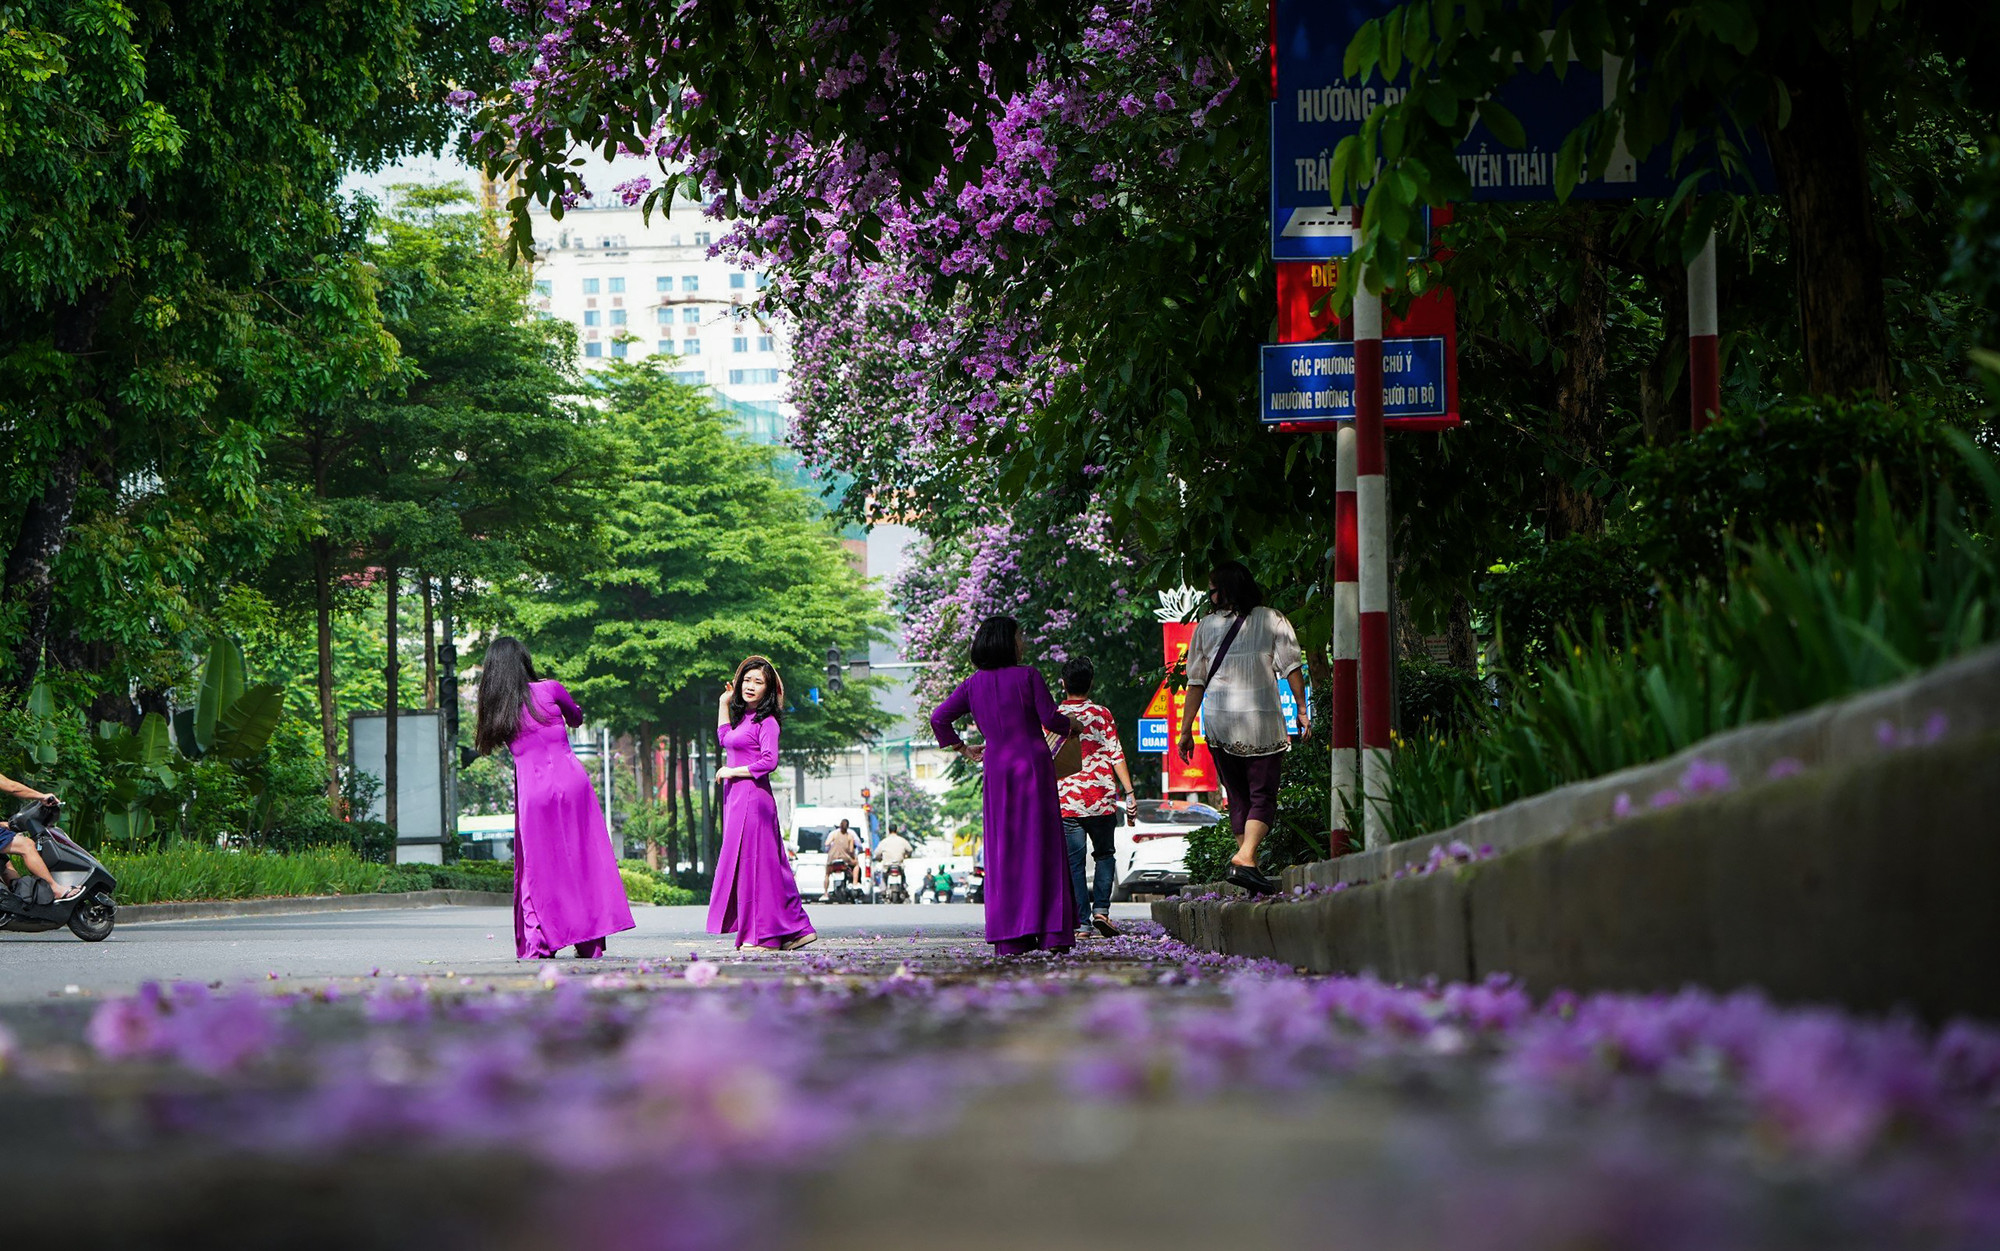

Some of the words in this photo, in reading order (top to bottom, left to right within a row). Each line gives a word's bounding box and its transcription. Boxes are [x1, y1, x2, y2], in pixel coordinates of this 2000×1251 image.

[1297, 78, 1377, 123] HƯỚNG
[1295, 148, 1333, 192] TRẦ
[1507, 145, 1547, 187] THÁI
[1291, 355, 1311, 377] CÁC
[1314, 355, 1355, 376] PHƯƠNG
[1382, 351, 1403, 373] CHÚ
[1405, 350, 1412, 372] Ý
[1271, 387, 1312, 410] NHƯỜNG
[1314, 385, 1350, 409] ĐƯỜNG
[1383, 382, 1405, 406] GƯỜI
[1407, 386, 1418, 405] ĐI
[1421, 382, 1435, 407] BỘ
